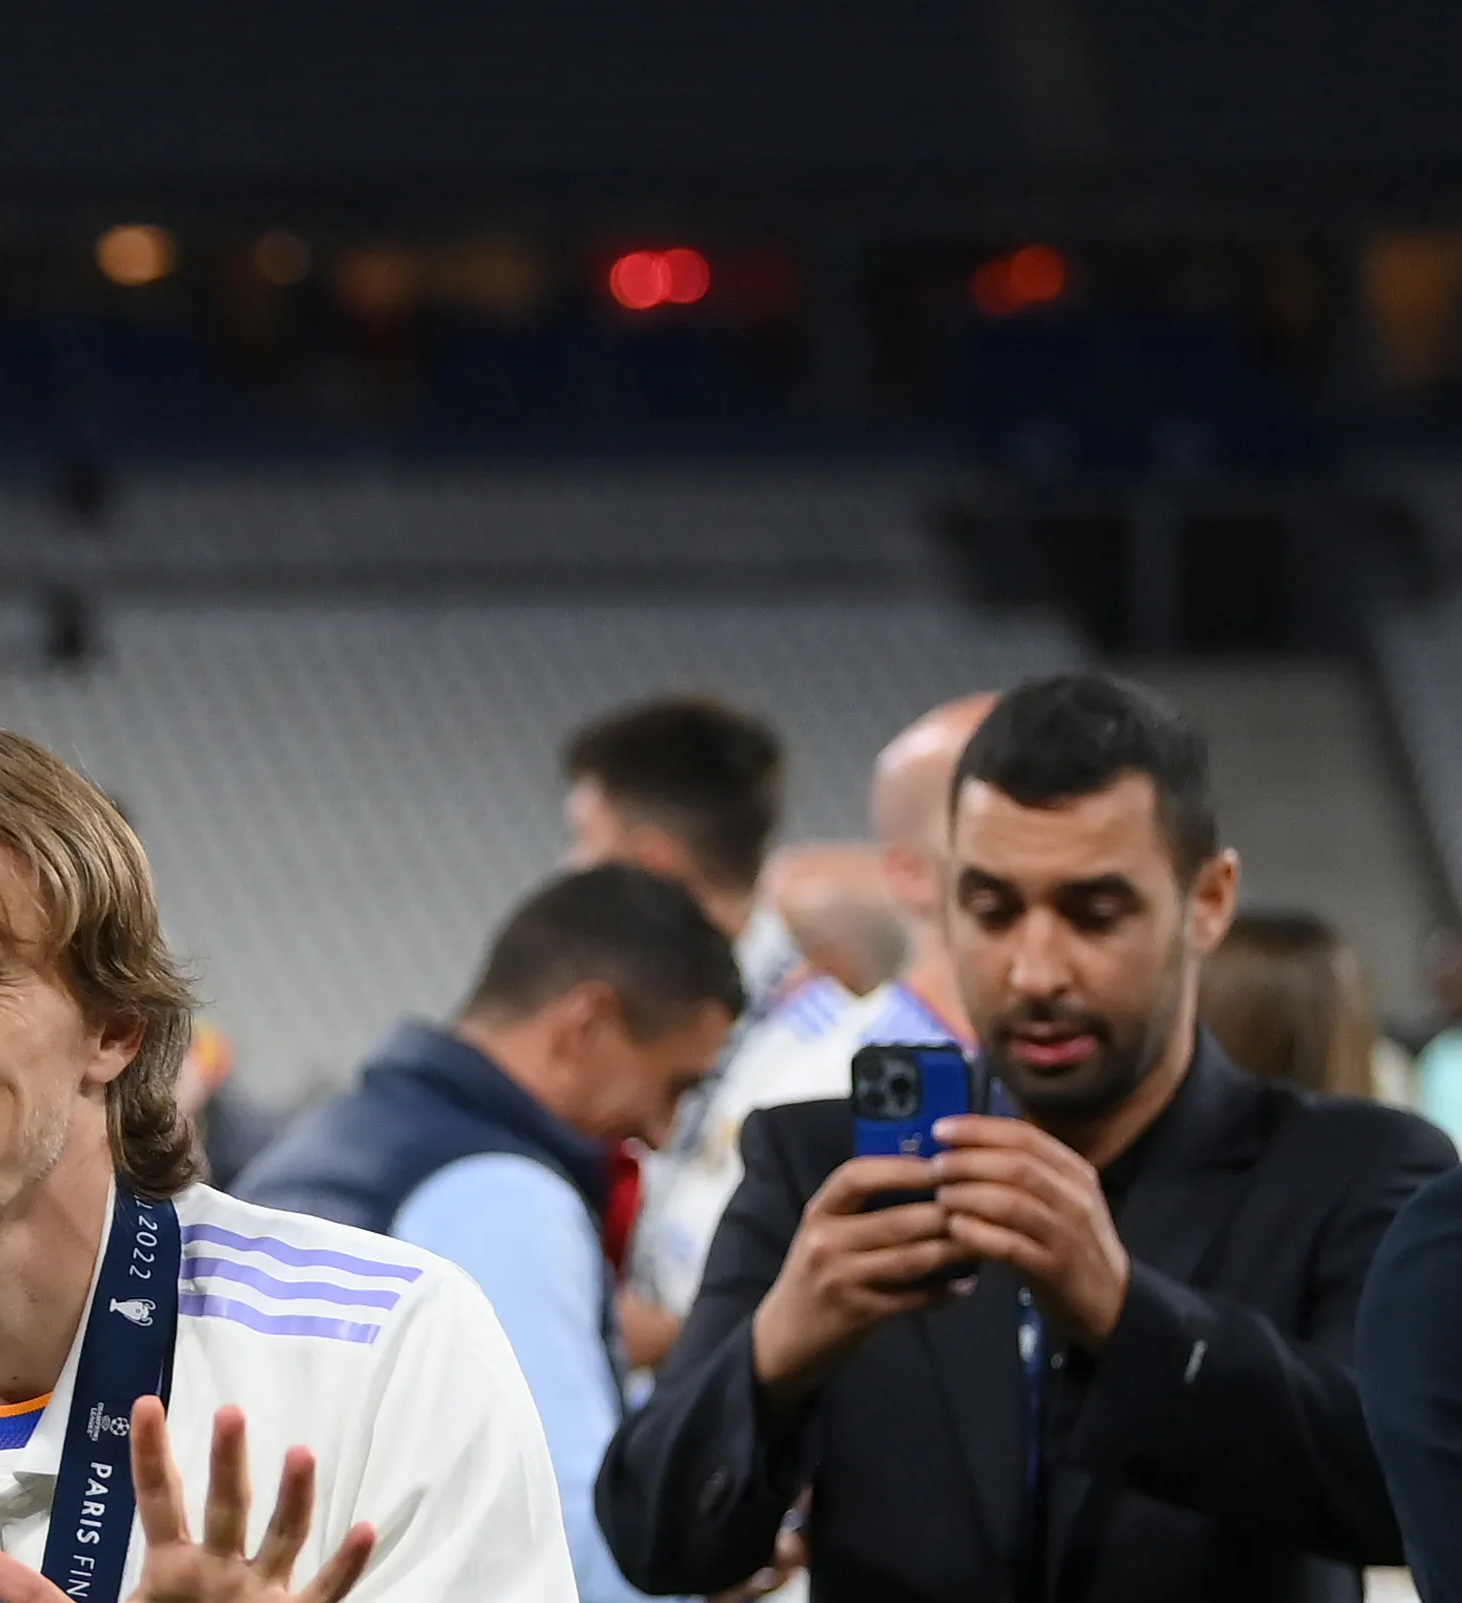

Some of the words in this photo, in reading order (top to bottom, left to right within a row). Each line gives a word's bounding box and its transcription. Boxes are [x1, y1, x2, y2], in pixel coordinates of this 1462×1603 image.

[129, 1215, 159, 1280] 2022
[76, 1461, 113, 1545] PARIS
[66, 1554, 96, 1598] FIN
